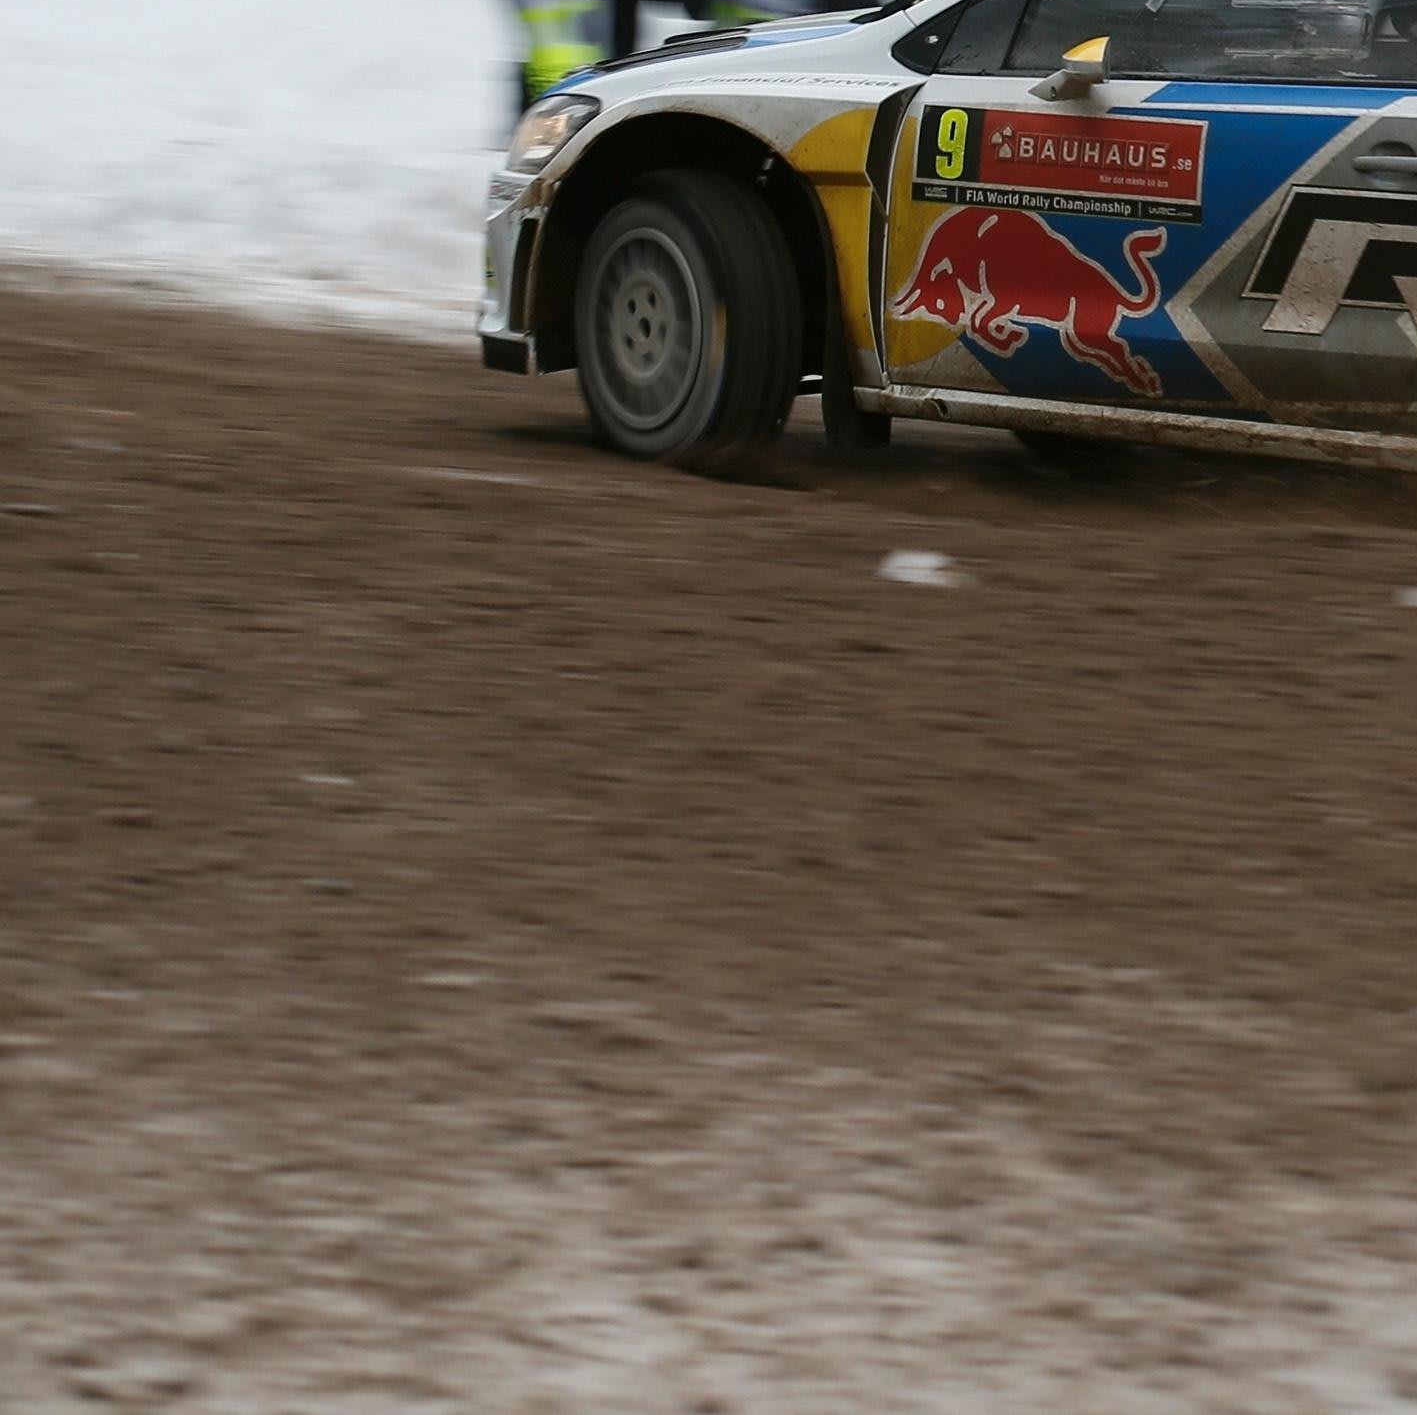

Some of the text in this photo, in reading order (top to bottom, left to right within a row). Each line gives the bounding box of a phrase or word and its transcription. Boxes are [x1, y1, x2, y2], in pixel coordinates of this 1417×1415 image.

[810, 76, 900, 87] Services
[935, 108, 968, 179] 9
[966, 189, 1132, 216] FIA World Rally Championship
